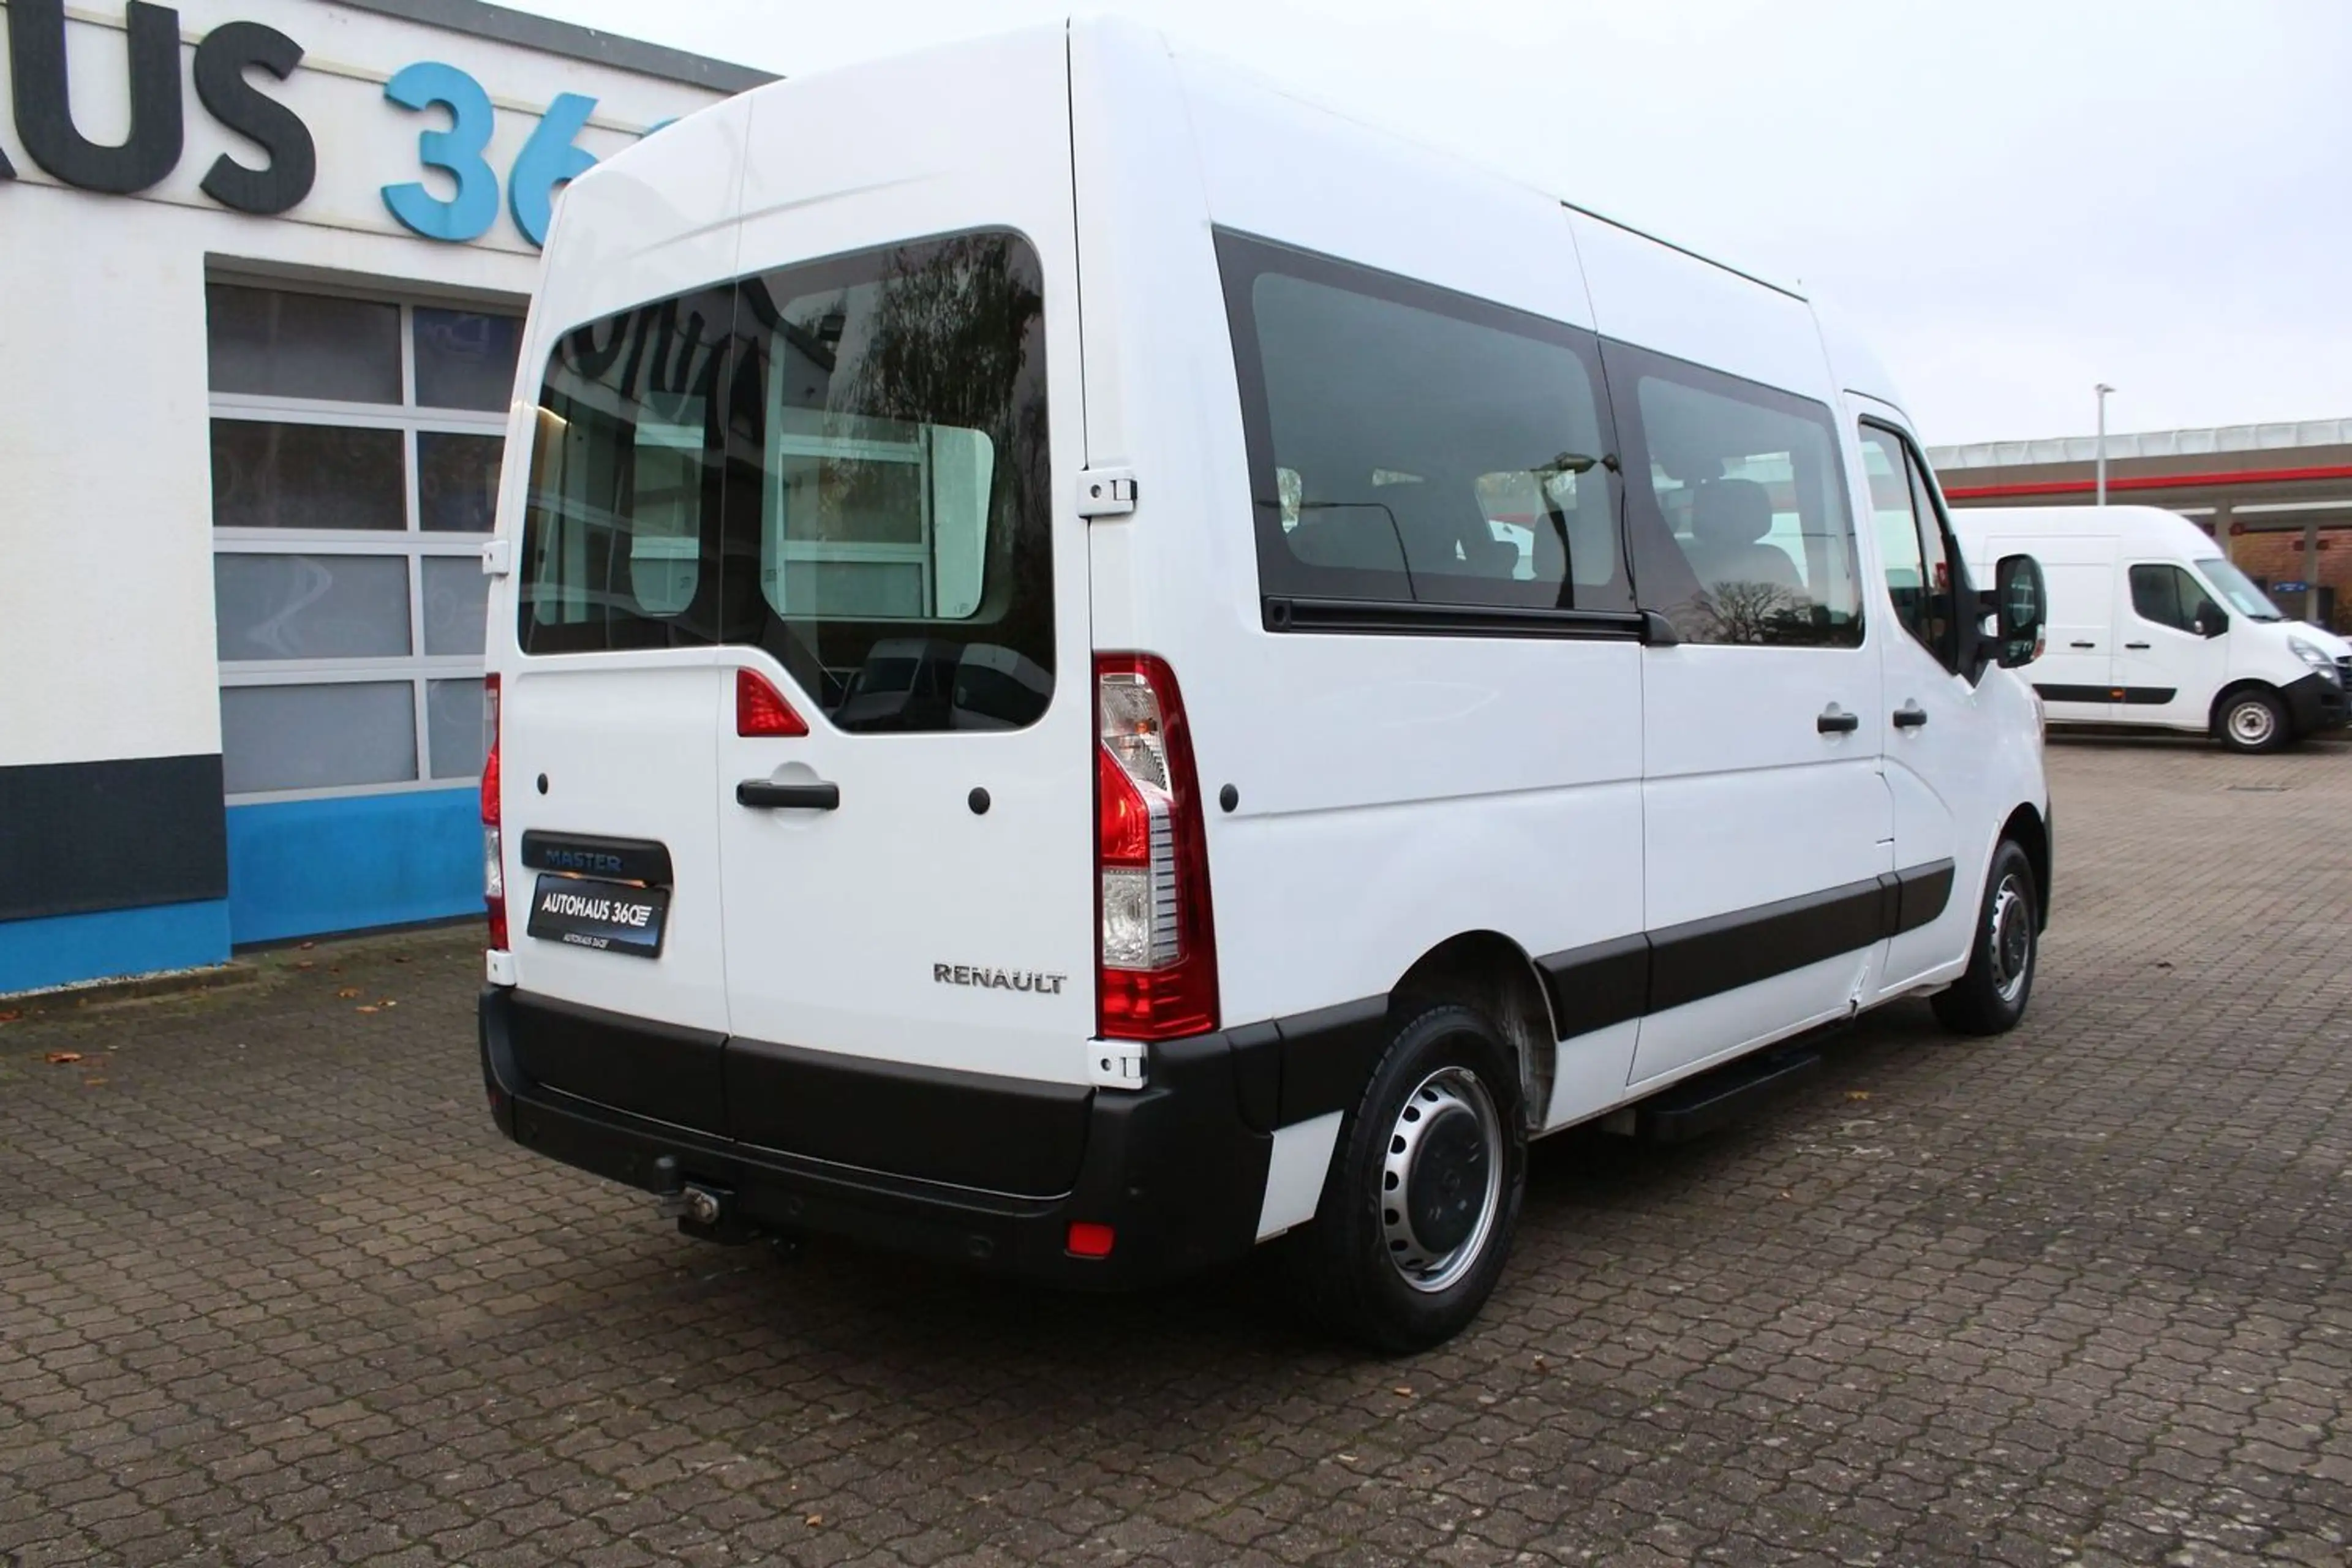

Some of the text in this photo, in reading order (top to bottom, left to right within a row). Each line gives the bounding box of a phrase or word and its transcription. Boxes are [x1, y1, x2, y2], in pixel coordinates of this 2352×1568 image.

[0, 0, 683, 249] US 36
[546, 850, 624, 872] MASTER
[541, 892, 611, 921] AUTOHAUS
[933, 963, 1067, 995] RENAULT
